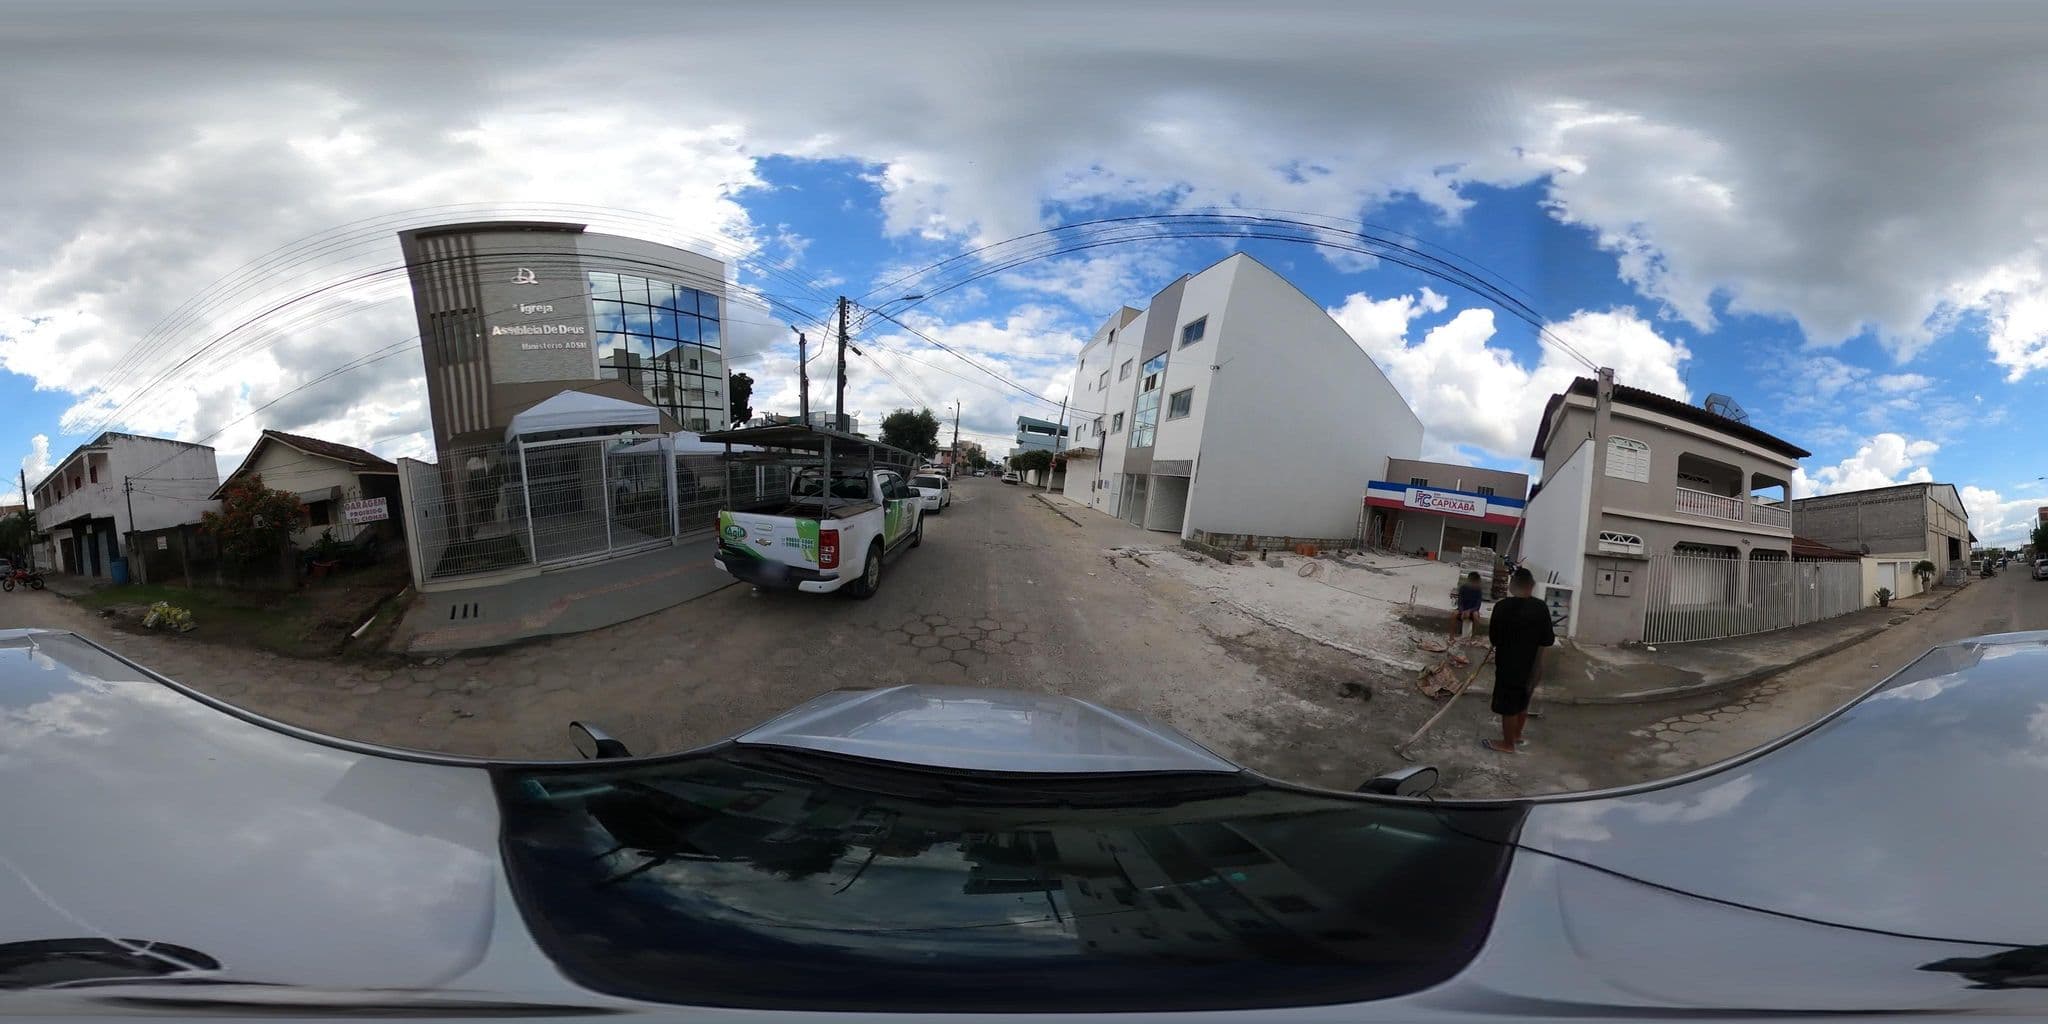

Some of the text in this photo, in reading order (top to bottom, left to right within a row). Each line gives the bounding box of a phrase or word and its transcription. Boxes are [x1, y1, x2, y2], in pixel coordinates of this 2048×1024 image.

[543, 325, 558, 334] De
[559, 325, 585, 334] Deus
[345, 498, 385, 511] GARAGEM
[1431, 498, 1475, 512] CAPIXABA
[350, 507, 383, 517] PROIBIDO
